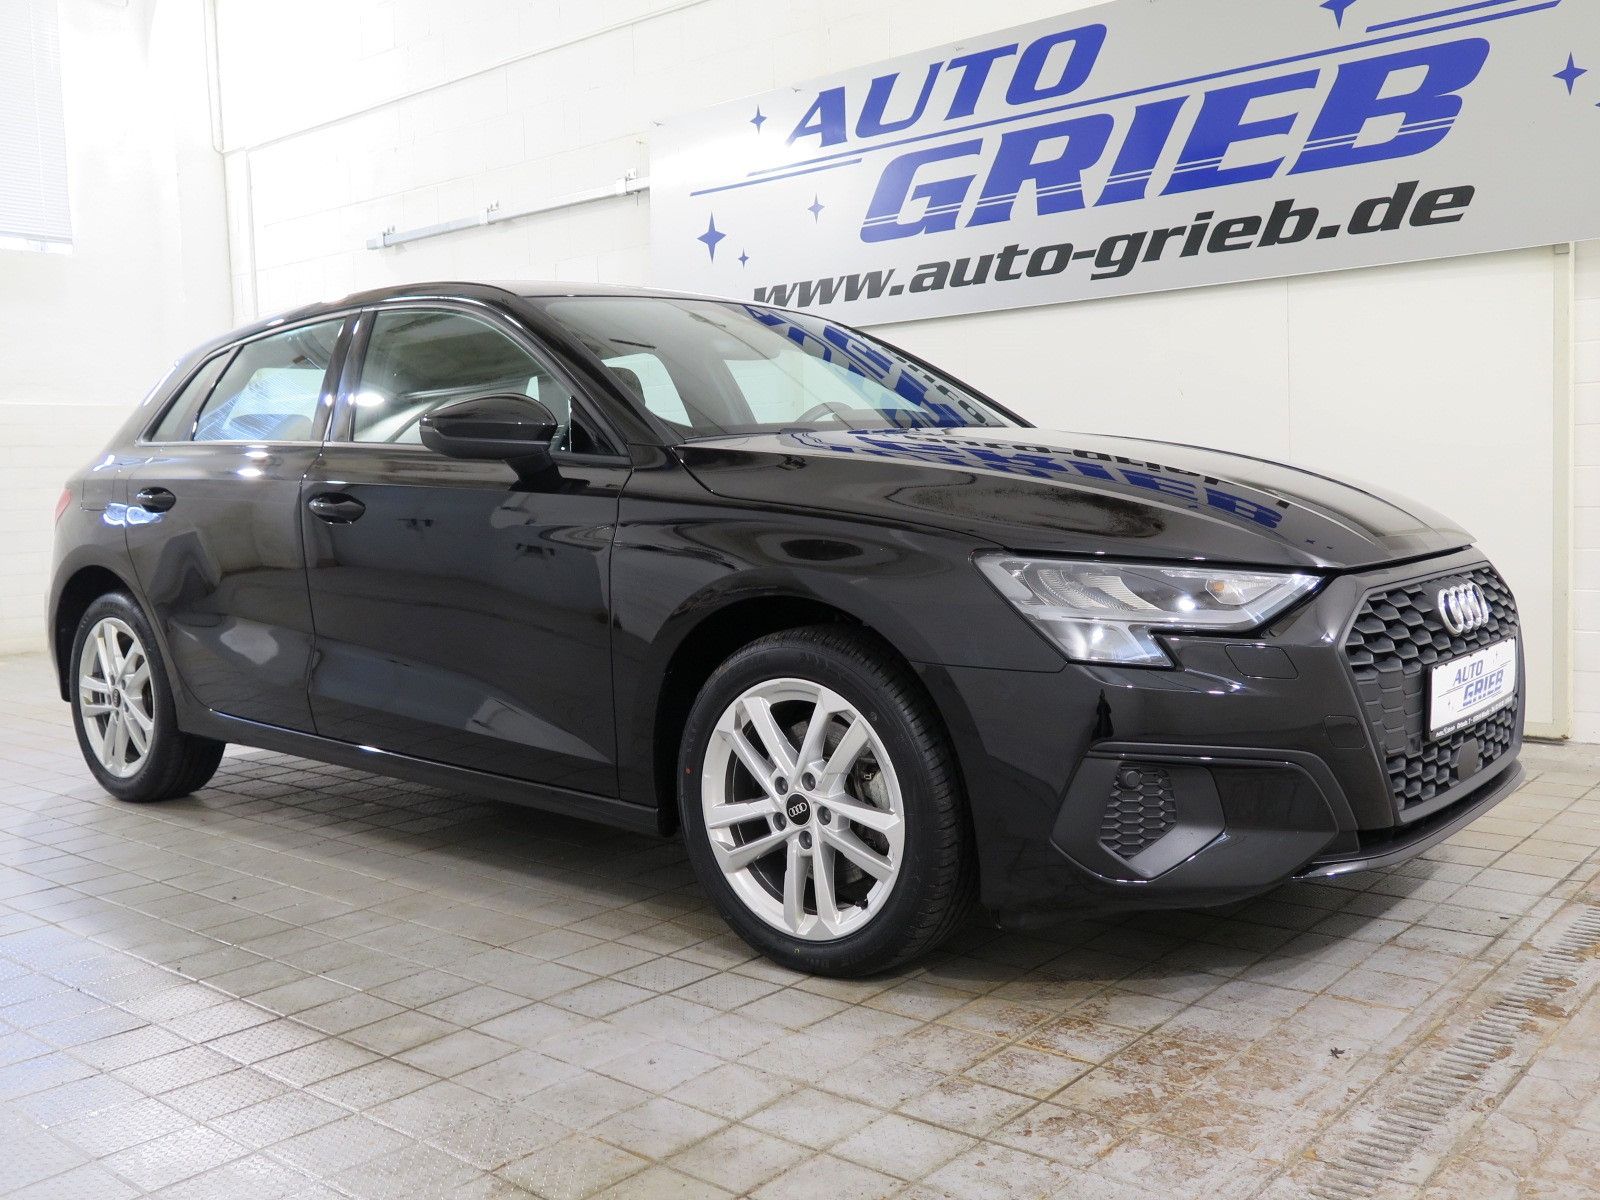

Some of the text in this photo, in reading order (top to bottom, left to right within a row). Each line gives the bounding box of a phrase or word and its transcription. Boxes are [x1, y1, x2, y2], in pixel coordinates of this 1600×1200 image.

[787, 24, 1108, 147] AUTO
[861, 38, 1490, 244] GRIEB
[753, 180, 1475, 308] www.auto-grieb.de
[1454, 660, 1483, 685] AUTO
[1463, 670, 1503, 706] GRIEB
